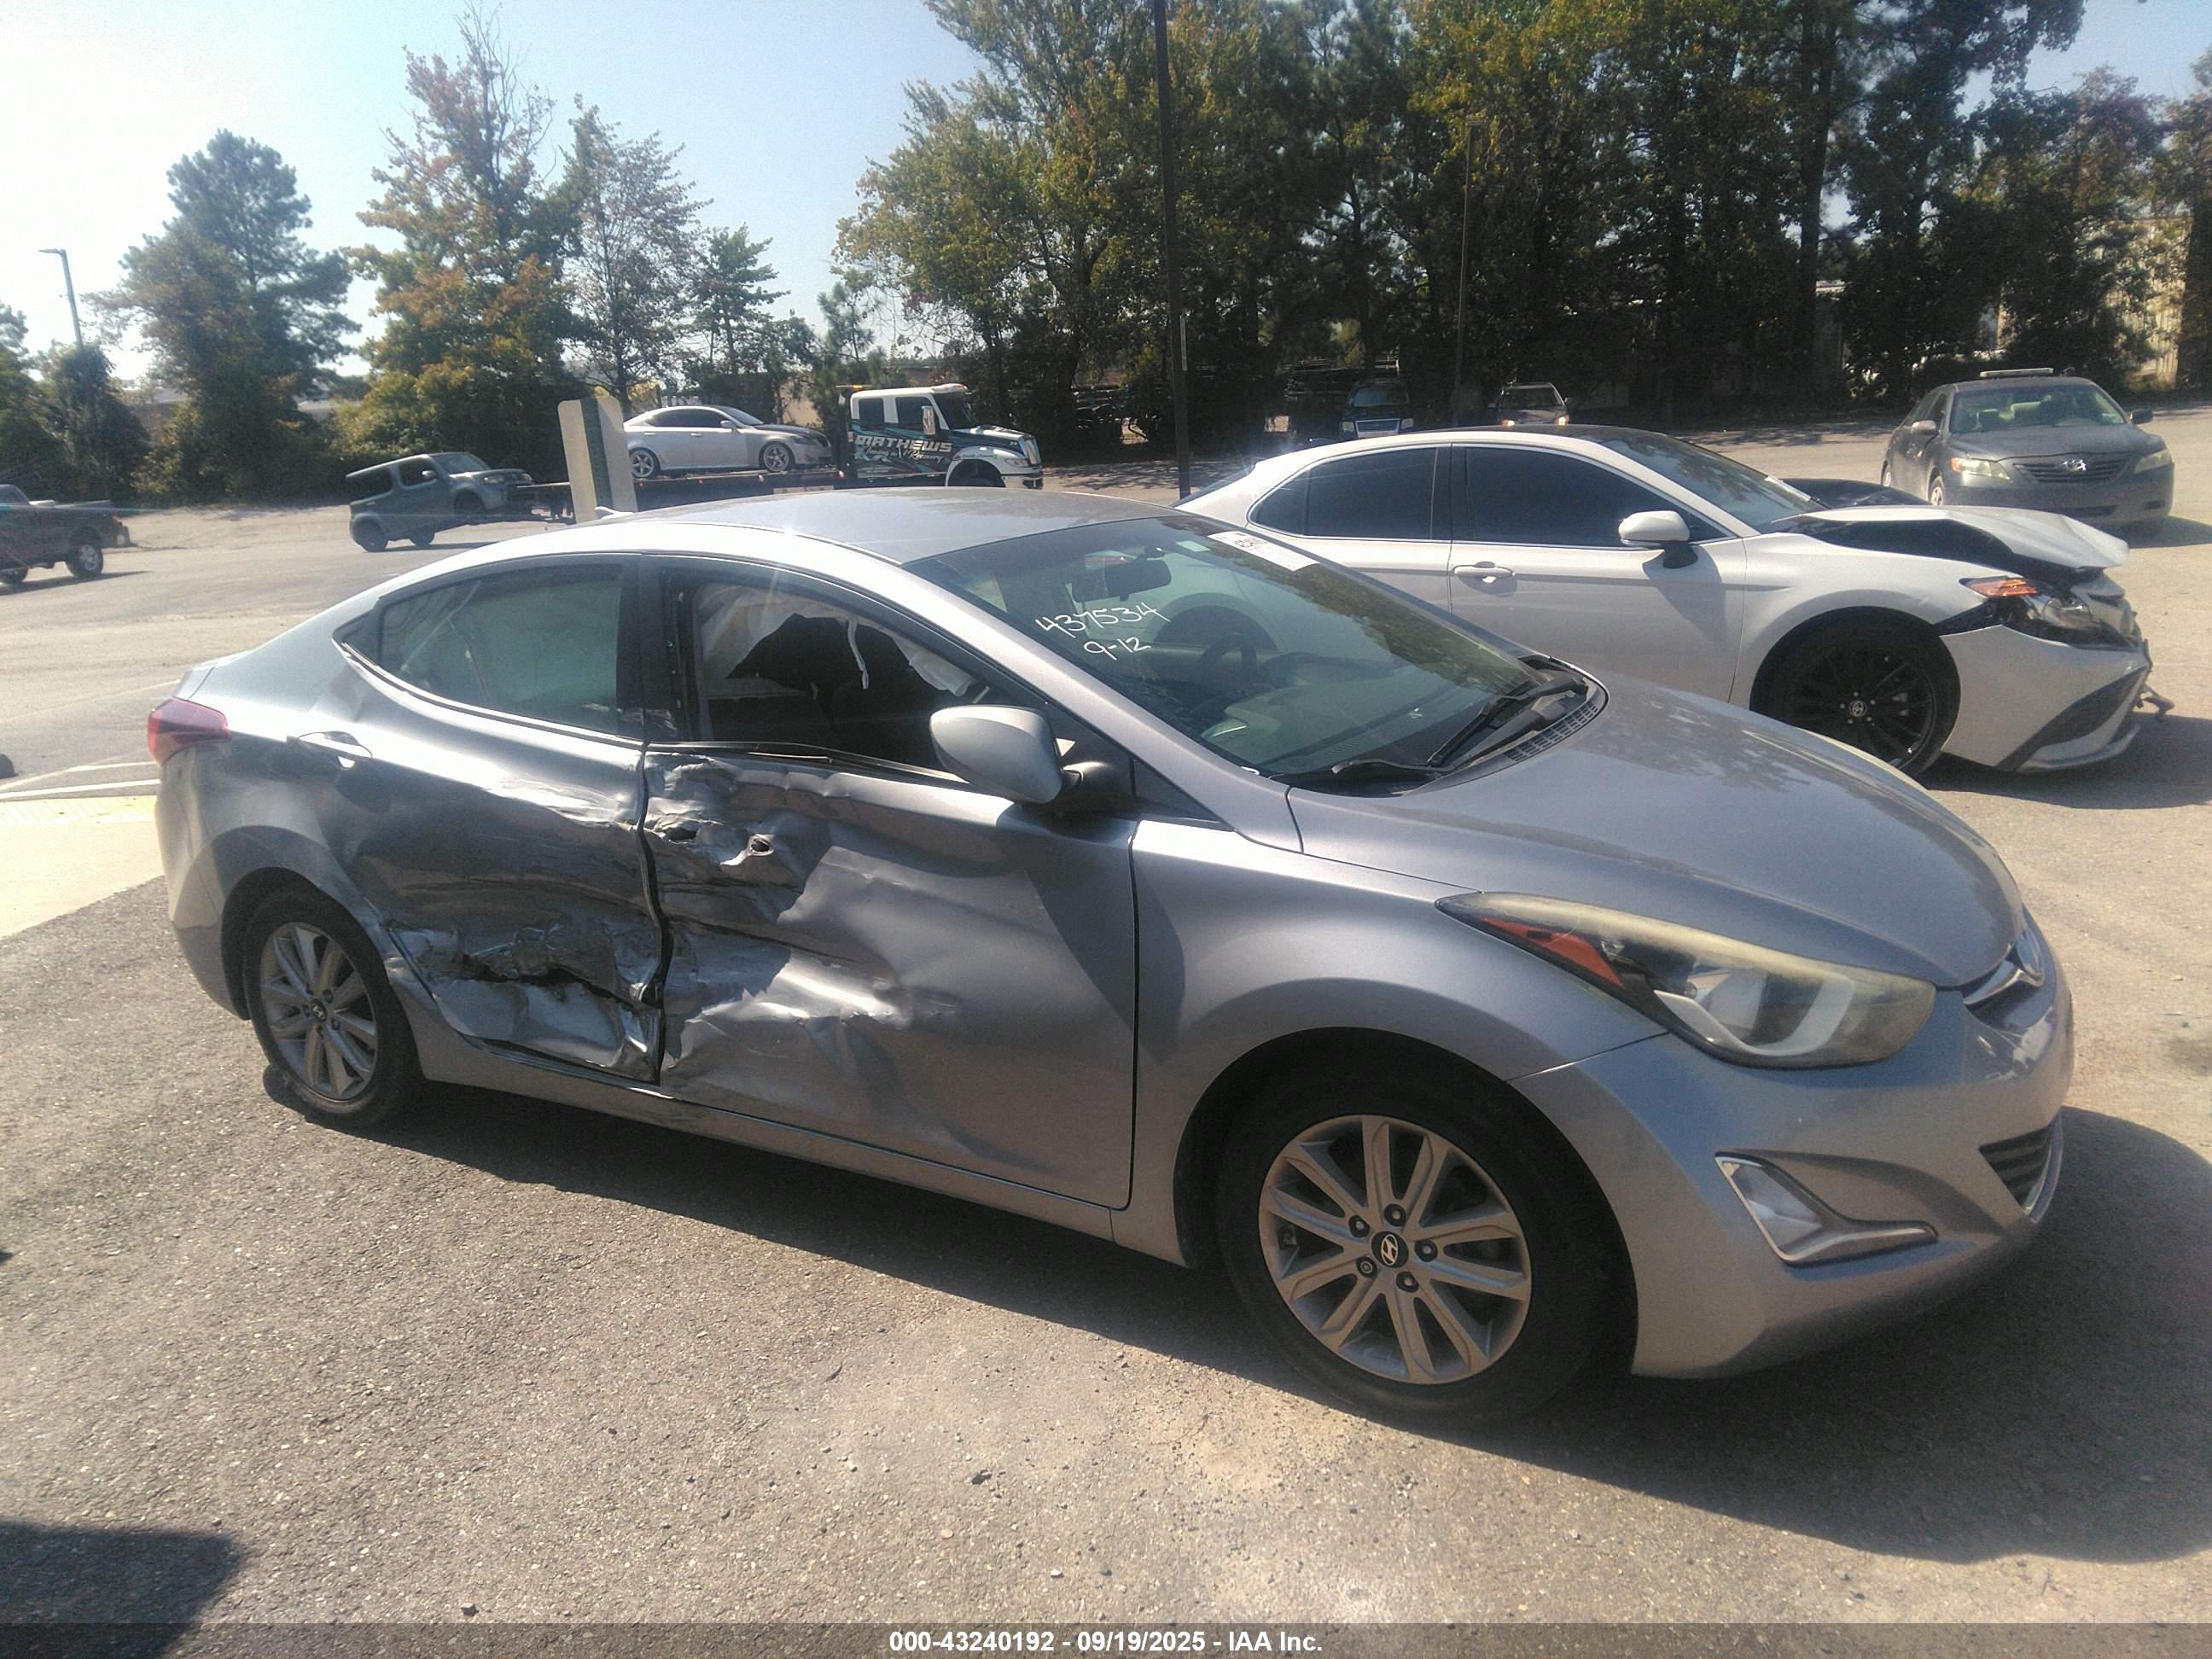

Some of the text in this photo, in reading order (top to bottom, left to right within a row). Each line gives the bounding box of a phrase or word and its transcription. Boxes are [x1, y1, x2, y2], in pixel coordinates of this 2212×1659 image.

[854, 435, 952, 452] MATHEWS
[1035, 602, 1171, 638] 437534
[1084, 637, 1151, 661] 9-12
